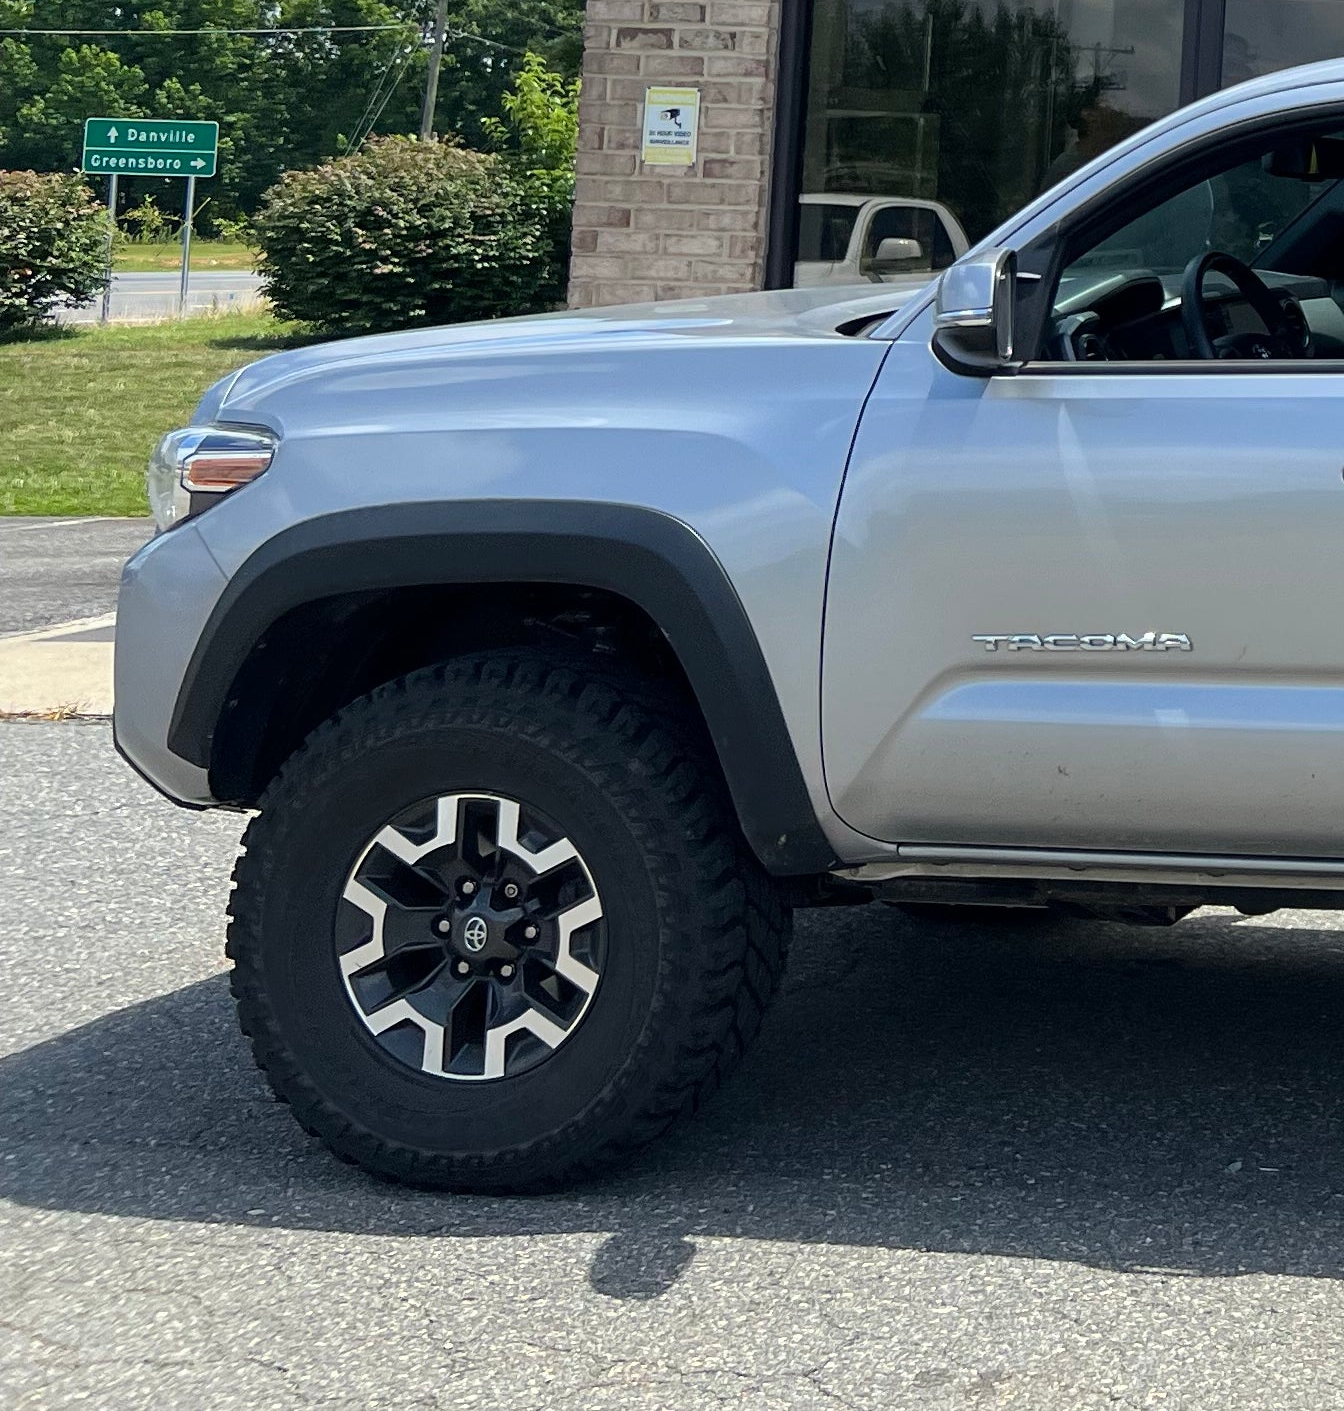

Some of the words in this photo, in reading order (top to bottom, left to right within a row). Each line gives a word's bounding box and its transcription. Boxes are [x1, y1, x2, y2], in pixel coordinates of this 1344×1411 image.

[127, 128, 196, 143] Danville
[90, 154, 182, 169] Greensboro
[971, 632, 1194, 652] TACOMA
